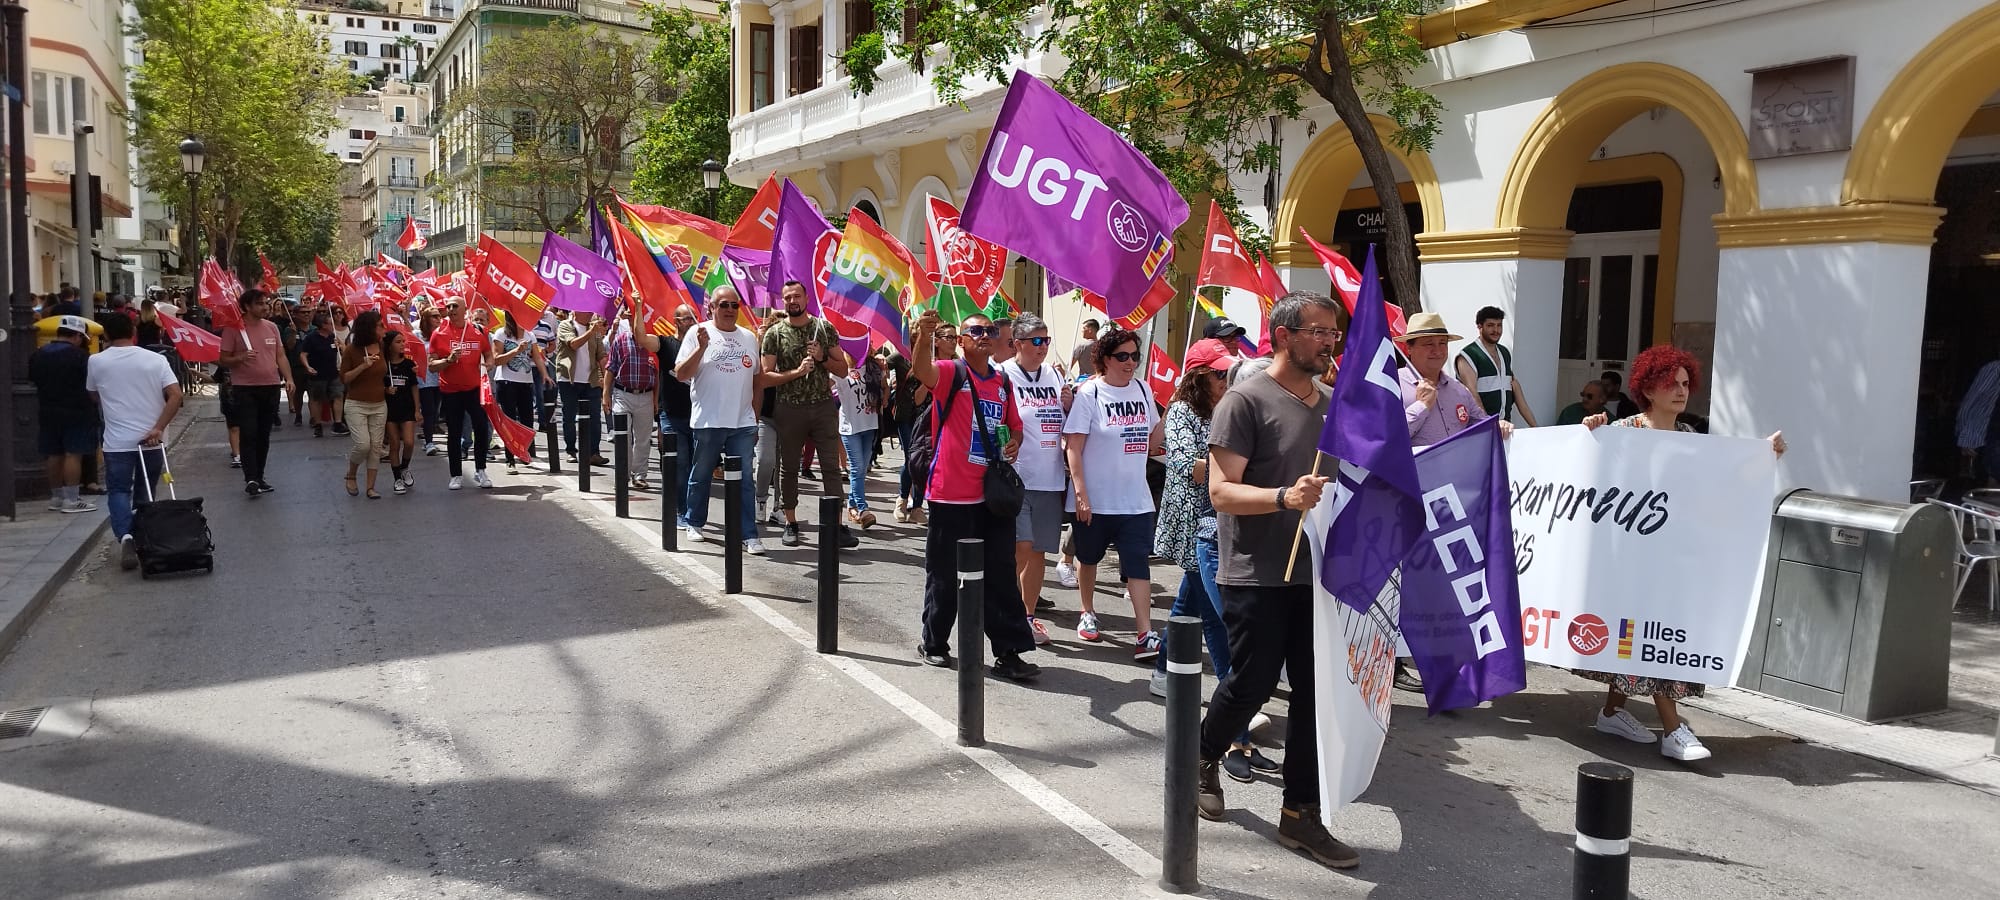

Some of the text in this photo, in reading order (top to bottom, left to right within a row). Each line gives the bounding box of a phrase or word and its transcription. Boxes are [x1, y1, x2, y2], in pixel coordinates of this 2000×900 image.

[1759, 96, 1839, 122] SPORT
[1600, 146, 1606, 159] 3
[987, 131, 1109, 221] UGT
[487, 262, 527, 301] CCOO
[540, 256, 592, 290] UGT
[836, 243, 900, 295] UGT
[1421, 483, 1508, 661] CCOO
[1521, 606, 1561, 650] GT
[1642, 620, 1687, 643] Illes
[1641, 644, 1725, 671] Balears
